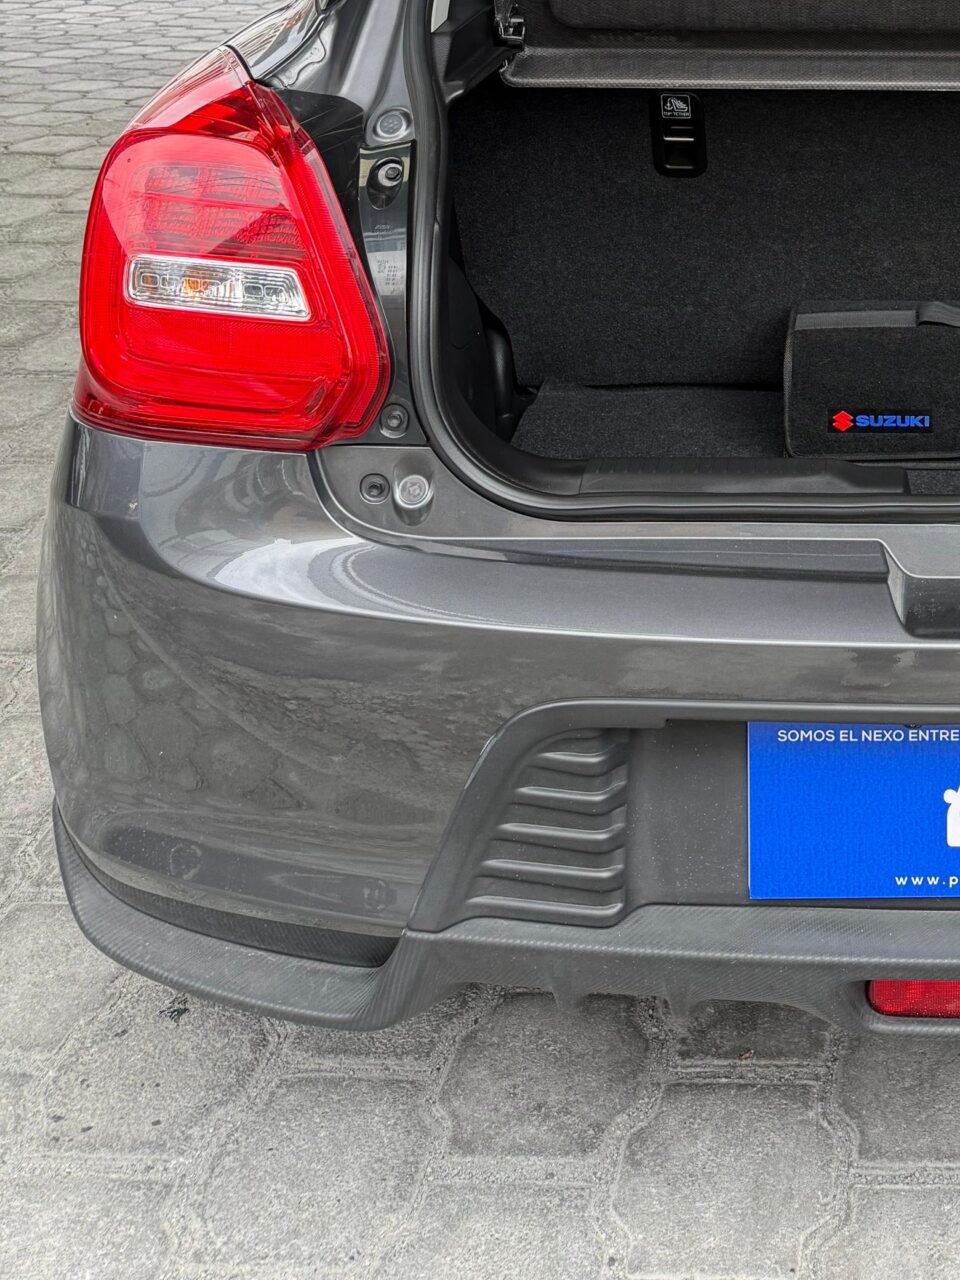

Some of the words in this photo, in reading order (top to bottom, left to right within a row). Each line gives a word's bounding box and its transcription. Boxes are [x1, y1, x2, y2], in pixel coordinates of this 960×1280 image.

[855, 415, 930, 427] SUZUKI
[777, 729, 836, 742] SOMOS
[839, 730, 858, 742] EL
[861, 729, 905, 742] NEXO
[908, 729, 960, 742] ENTRE
